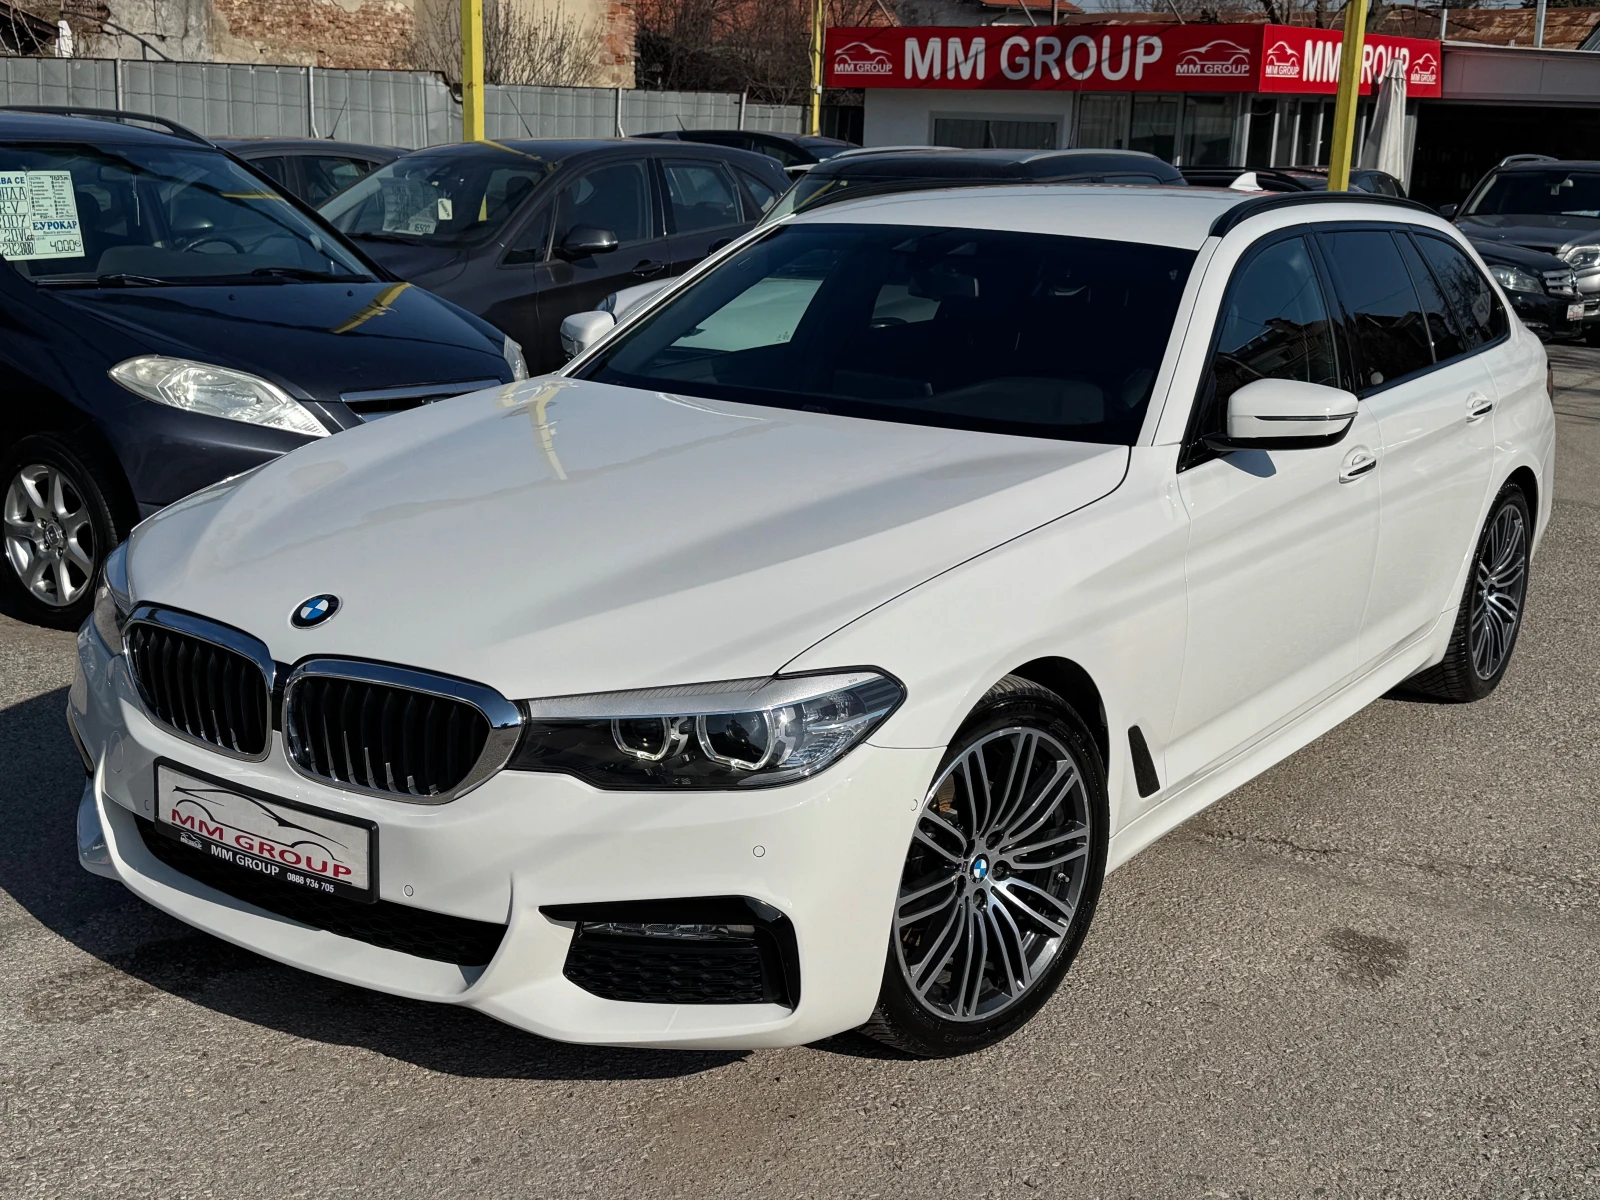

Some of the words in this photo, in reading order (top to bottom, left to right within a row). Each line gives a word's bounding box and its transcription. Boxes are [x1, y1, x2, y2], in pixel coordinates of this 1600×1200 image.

[904, 37, 986, 81] MM
[1000, 34, 1163, 81] GROUP
[834, 63, 855, 72] MM
[856, 63, 893, 72] GROUP
[1175, 64, 1200, 74] MM
[1203, 64, 1250, 74] GROUP
[1265, 65, 1278, 75] MM
[1278, 65, 1300, 76] GROUP
[32, 220, 77, 231] ЕУРОКАР
[171, 808, 224, 841] MM
[234, 834, 352, 878] GROUP
[211, 844, 233, 862] MM
[236, 854, 280, 876] GROUP
[287, 872, 305, 885] 0888
[306, 877, 319, 889] 936
[320, 881, 335, 893] 705
